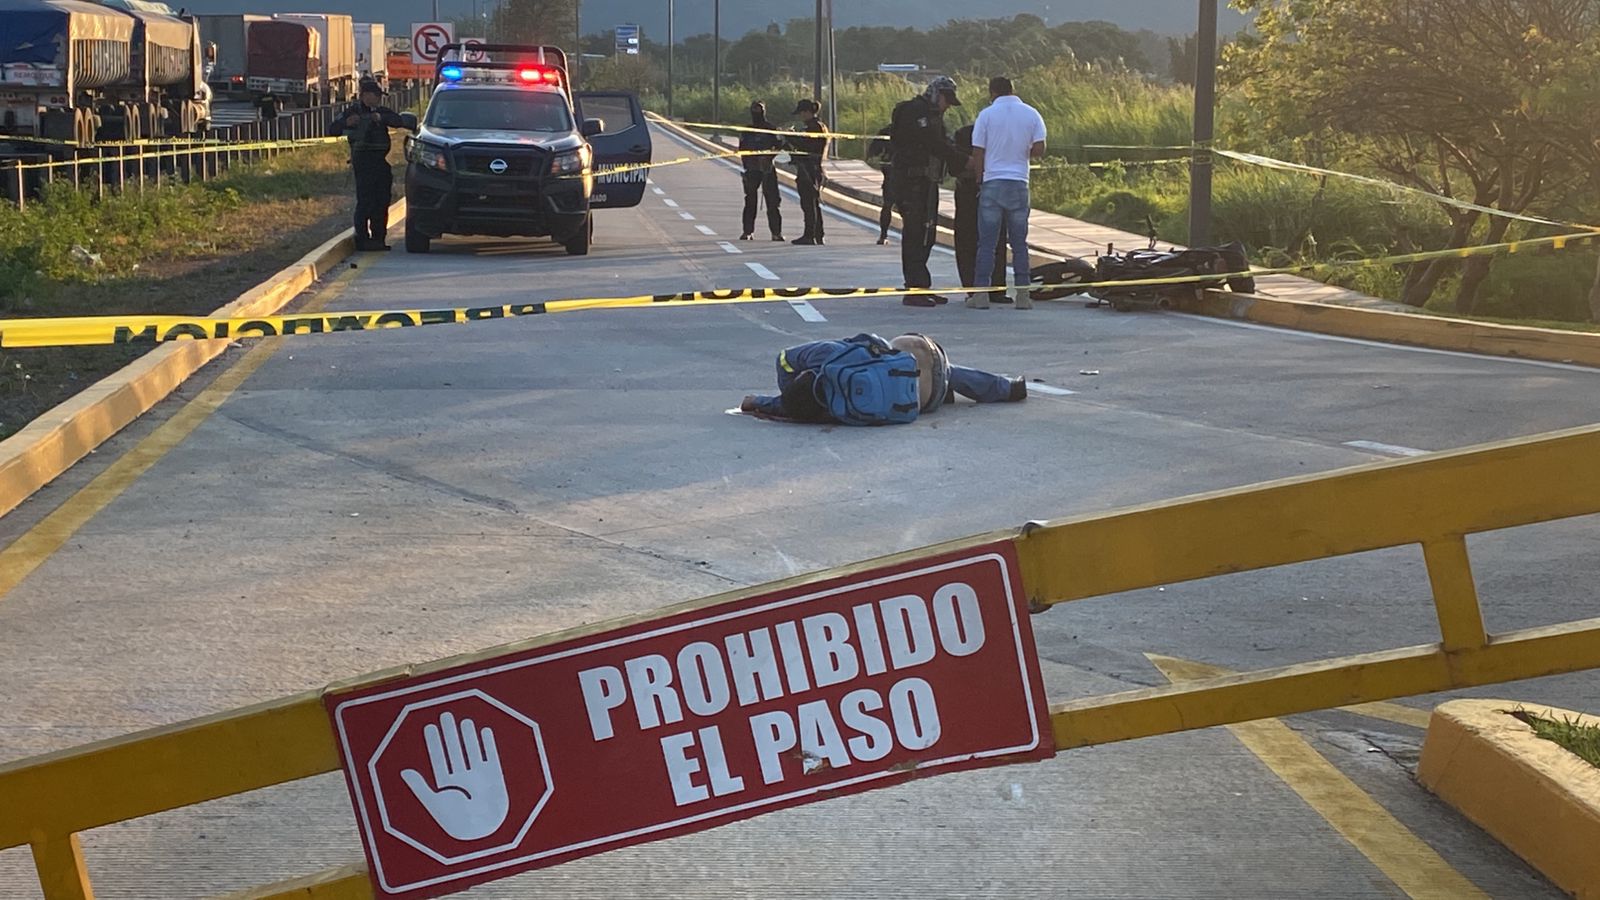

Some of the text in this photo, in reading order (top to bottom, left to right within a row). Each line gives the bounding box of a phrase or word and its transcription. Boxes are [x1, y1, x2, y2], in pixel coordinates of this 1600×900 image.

[577, 581, 986, 741] PROHIBIDO
[660, 677, 943, 806] EL PASO
